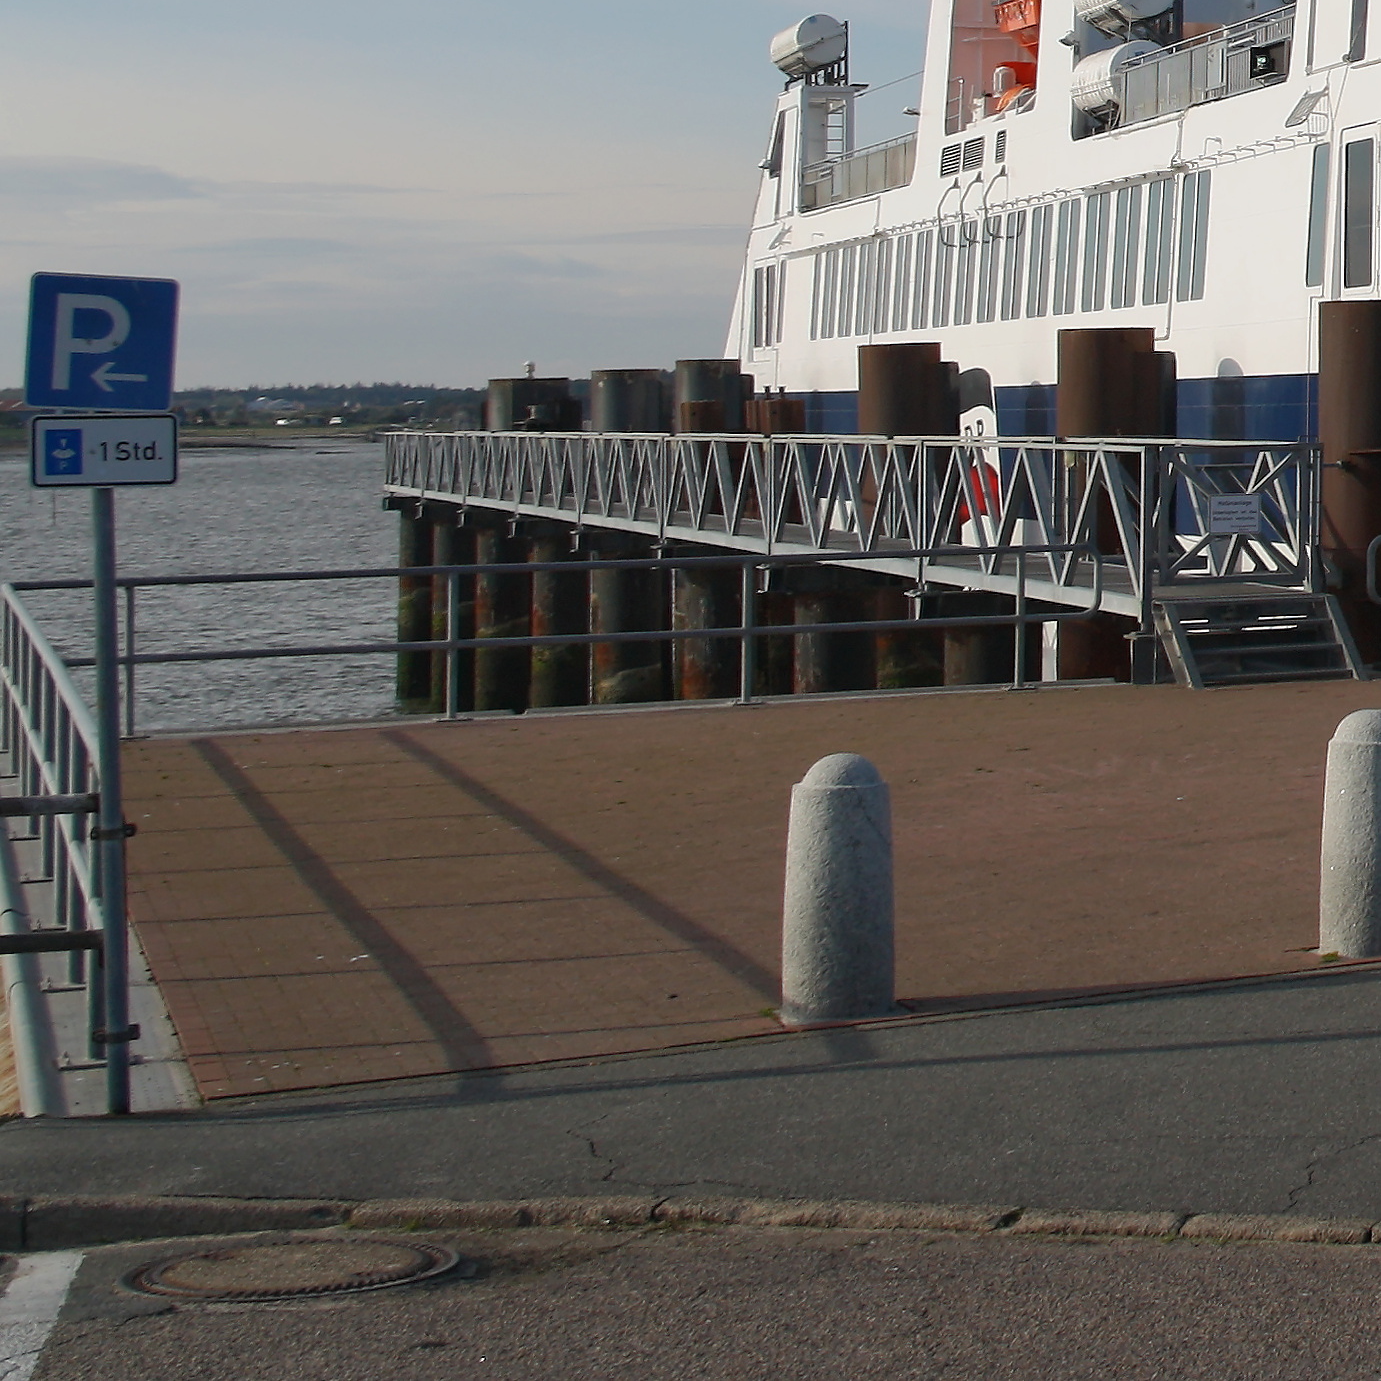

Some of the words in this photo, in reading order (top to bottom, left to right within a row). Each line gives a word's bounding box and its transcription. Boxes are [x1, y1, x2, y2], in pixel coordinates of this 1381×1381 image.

[52, 292, 132, 391] P
[100, 441, 108, 461] 1
[115, 441, 163, 461] Std.
